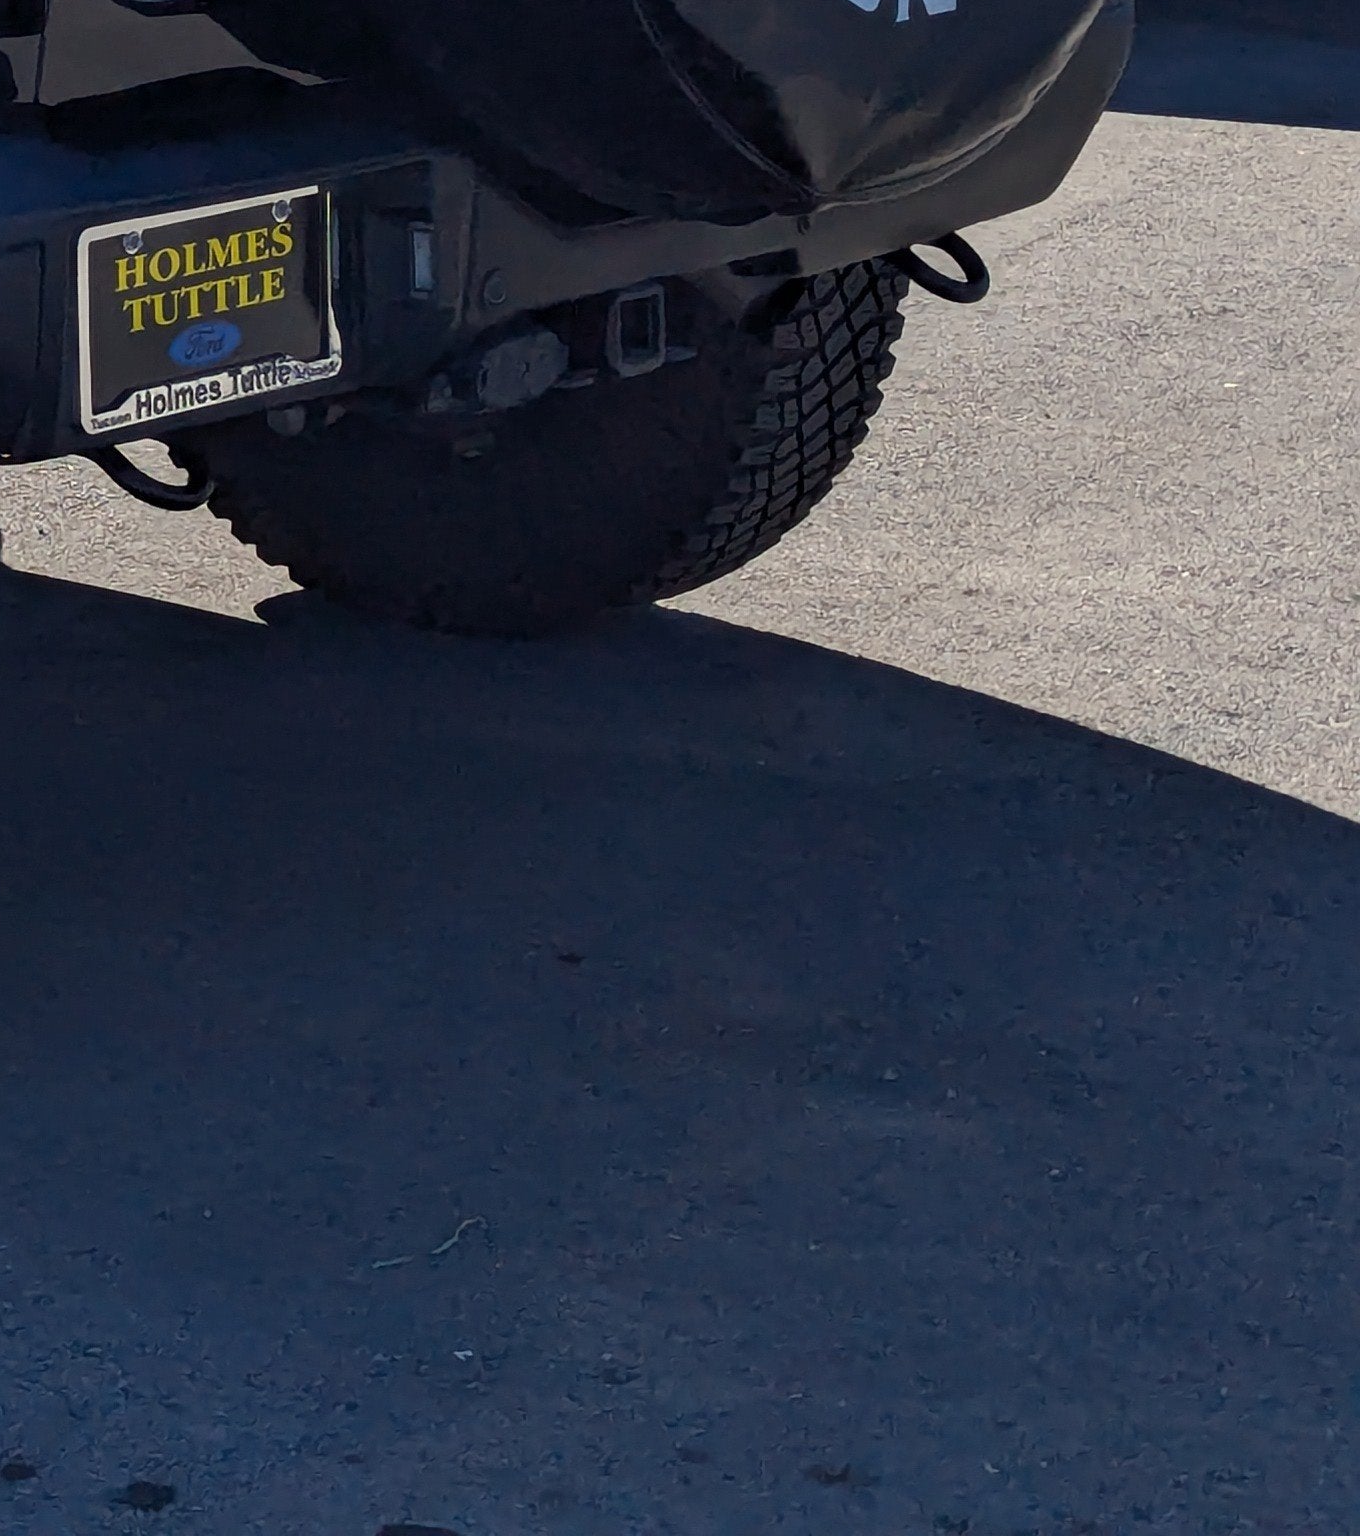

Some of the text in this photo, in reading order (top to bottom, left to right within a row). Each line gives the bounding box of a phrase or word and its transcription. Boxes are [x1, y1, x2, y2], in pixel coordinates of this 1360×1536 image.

[114, 222, 294, 293] HOLMES
[122, 267, 286, 334] TUTTLE
[135, 382, 222, 420] Holmes
